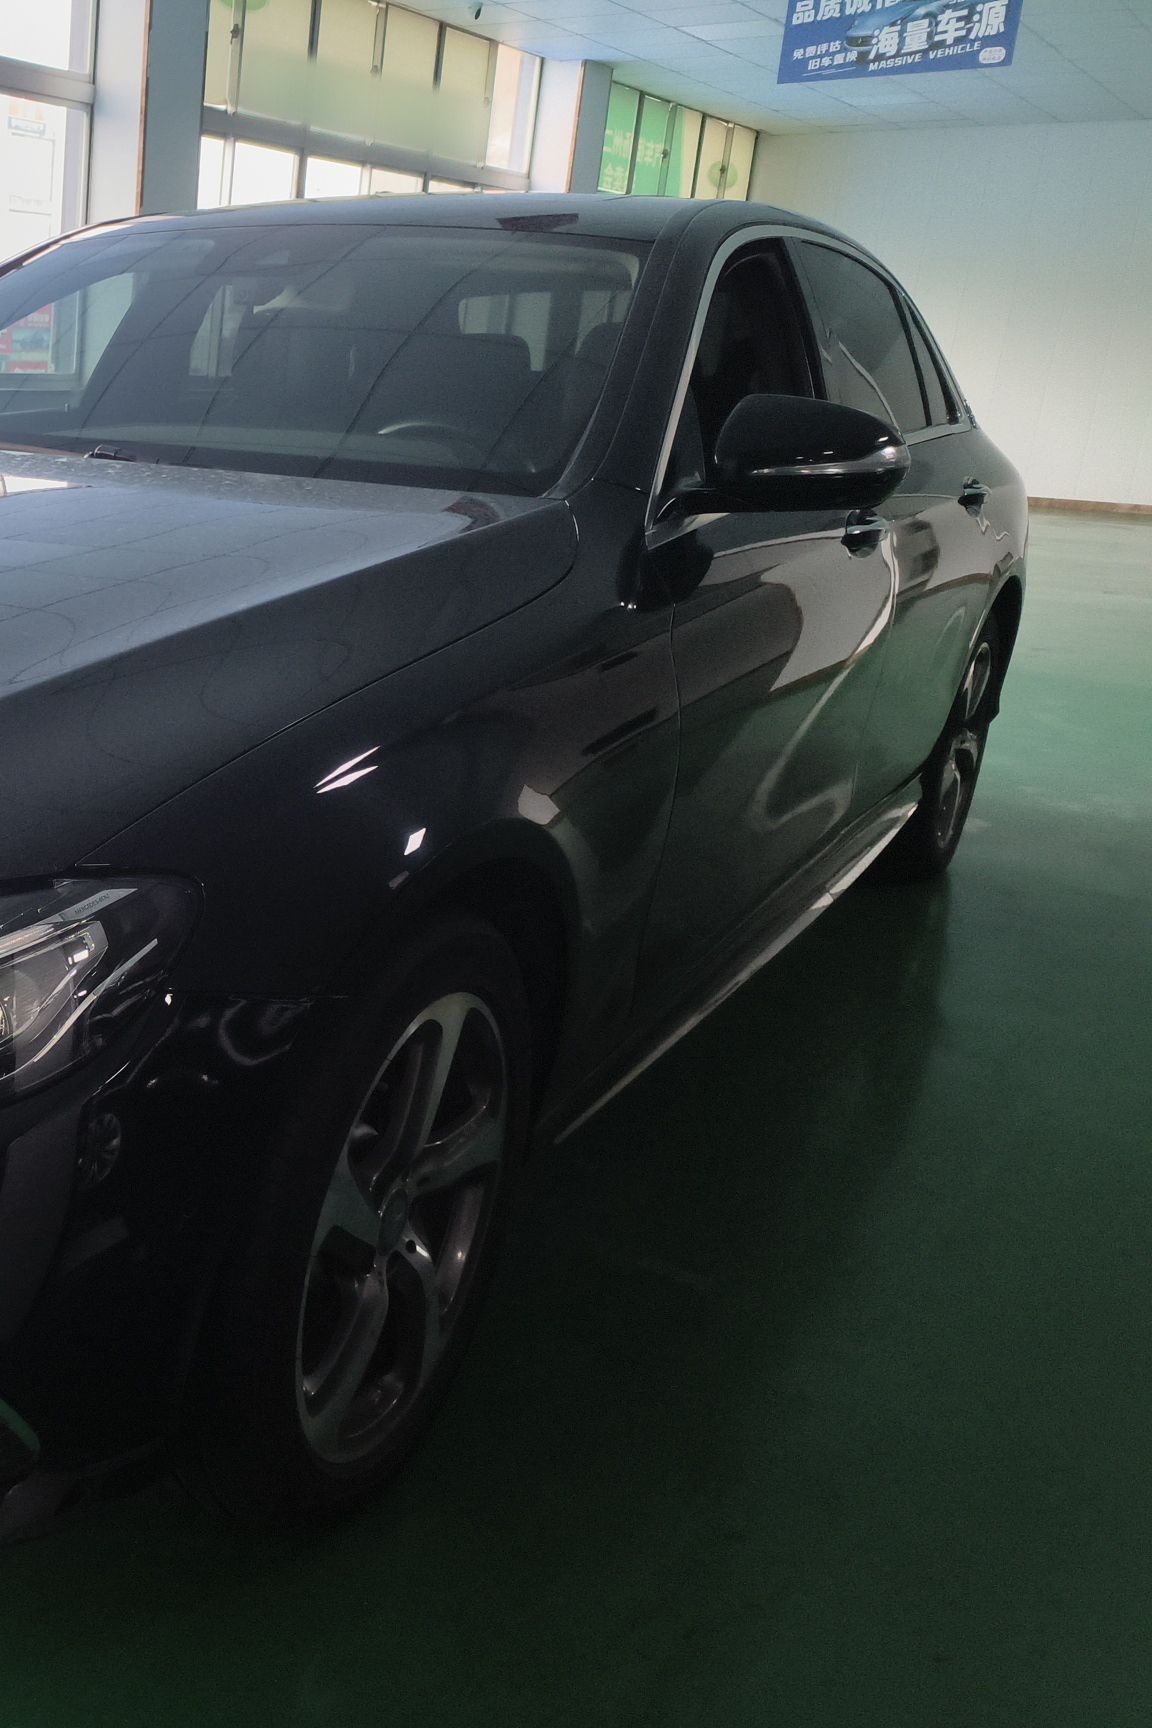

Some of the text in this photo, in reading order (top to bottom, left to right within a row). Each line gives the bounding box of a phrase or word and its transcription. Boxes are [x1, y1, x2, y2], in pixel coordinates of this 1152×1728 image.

[868, 0, 1008, 60] 海量车源
[793, 40, 842, 60] 免费评估
[808, 51, 858, 71] 旧车置换
[868, 53, 923, 71] MASSIVE
[929, 41, 982, 59] VEHICLE
